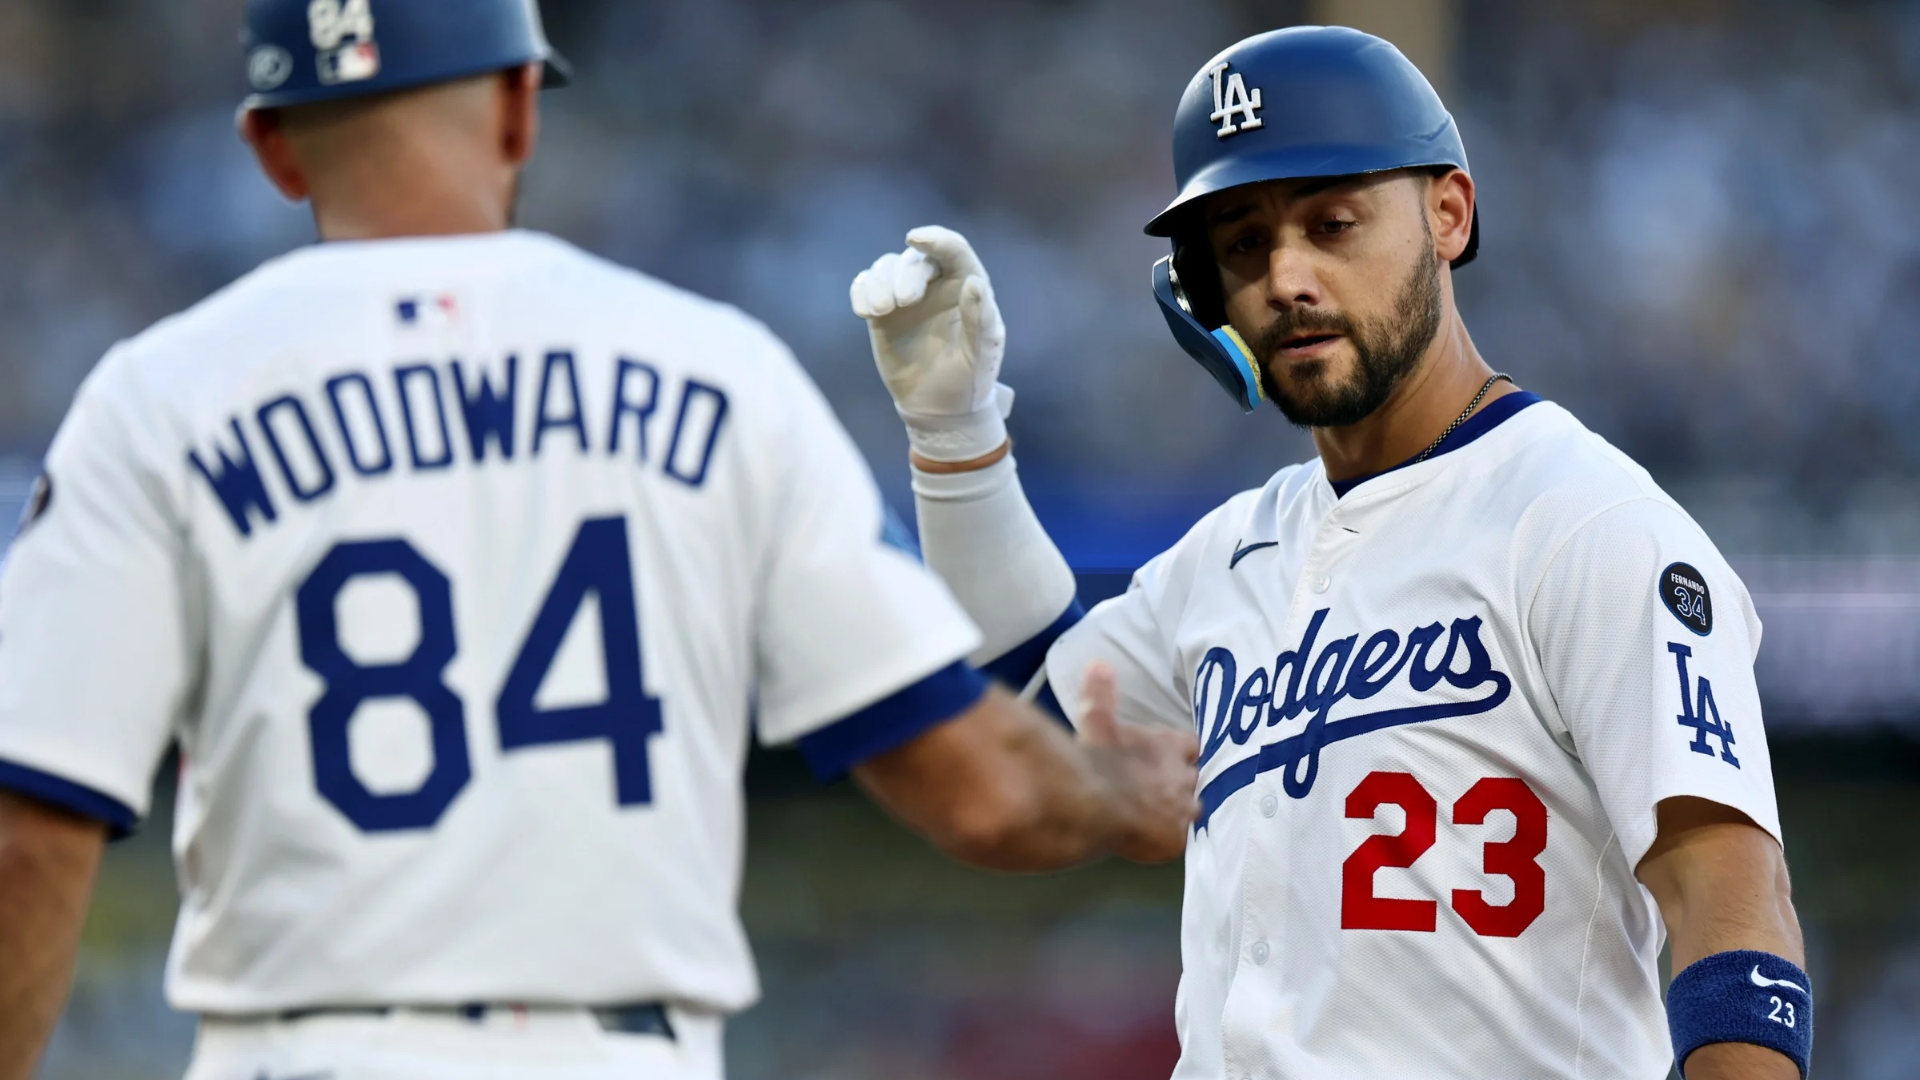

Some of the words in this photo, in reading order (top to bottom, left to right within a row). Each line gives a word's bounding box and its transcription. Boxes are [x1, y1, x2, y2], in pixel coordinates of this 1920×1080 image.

[307, 0, 374, 49] 84
[1210, 62, 1262, 138] LA
[188, 350, 730, 538] WOODWARD
[1670, 572, 1705, 595] FERNANDO
[1674, 586, 1706, 626] 34
[295, 514, 664, 834] 84
[1194, 607, 1512, 800] Dodgers
[1667, 641, 1741, 770] LA
[1341, 771, 1548, 938] 23
[1768, 996, 1795, 1028] 23
